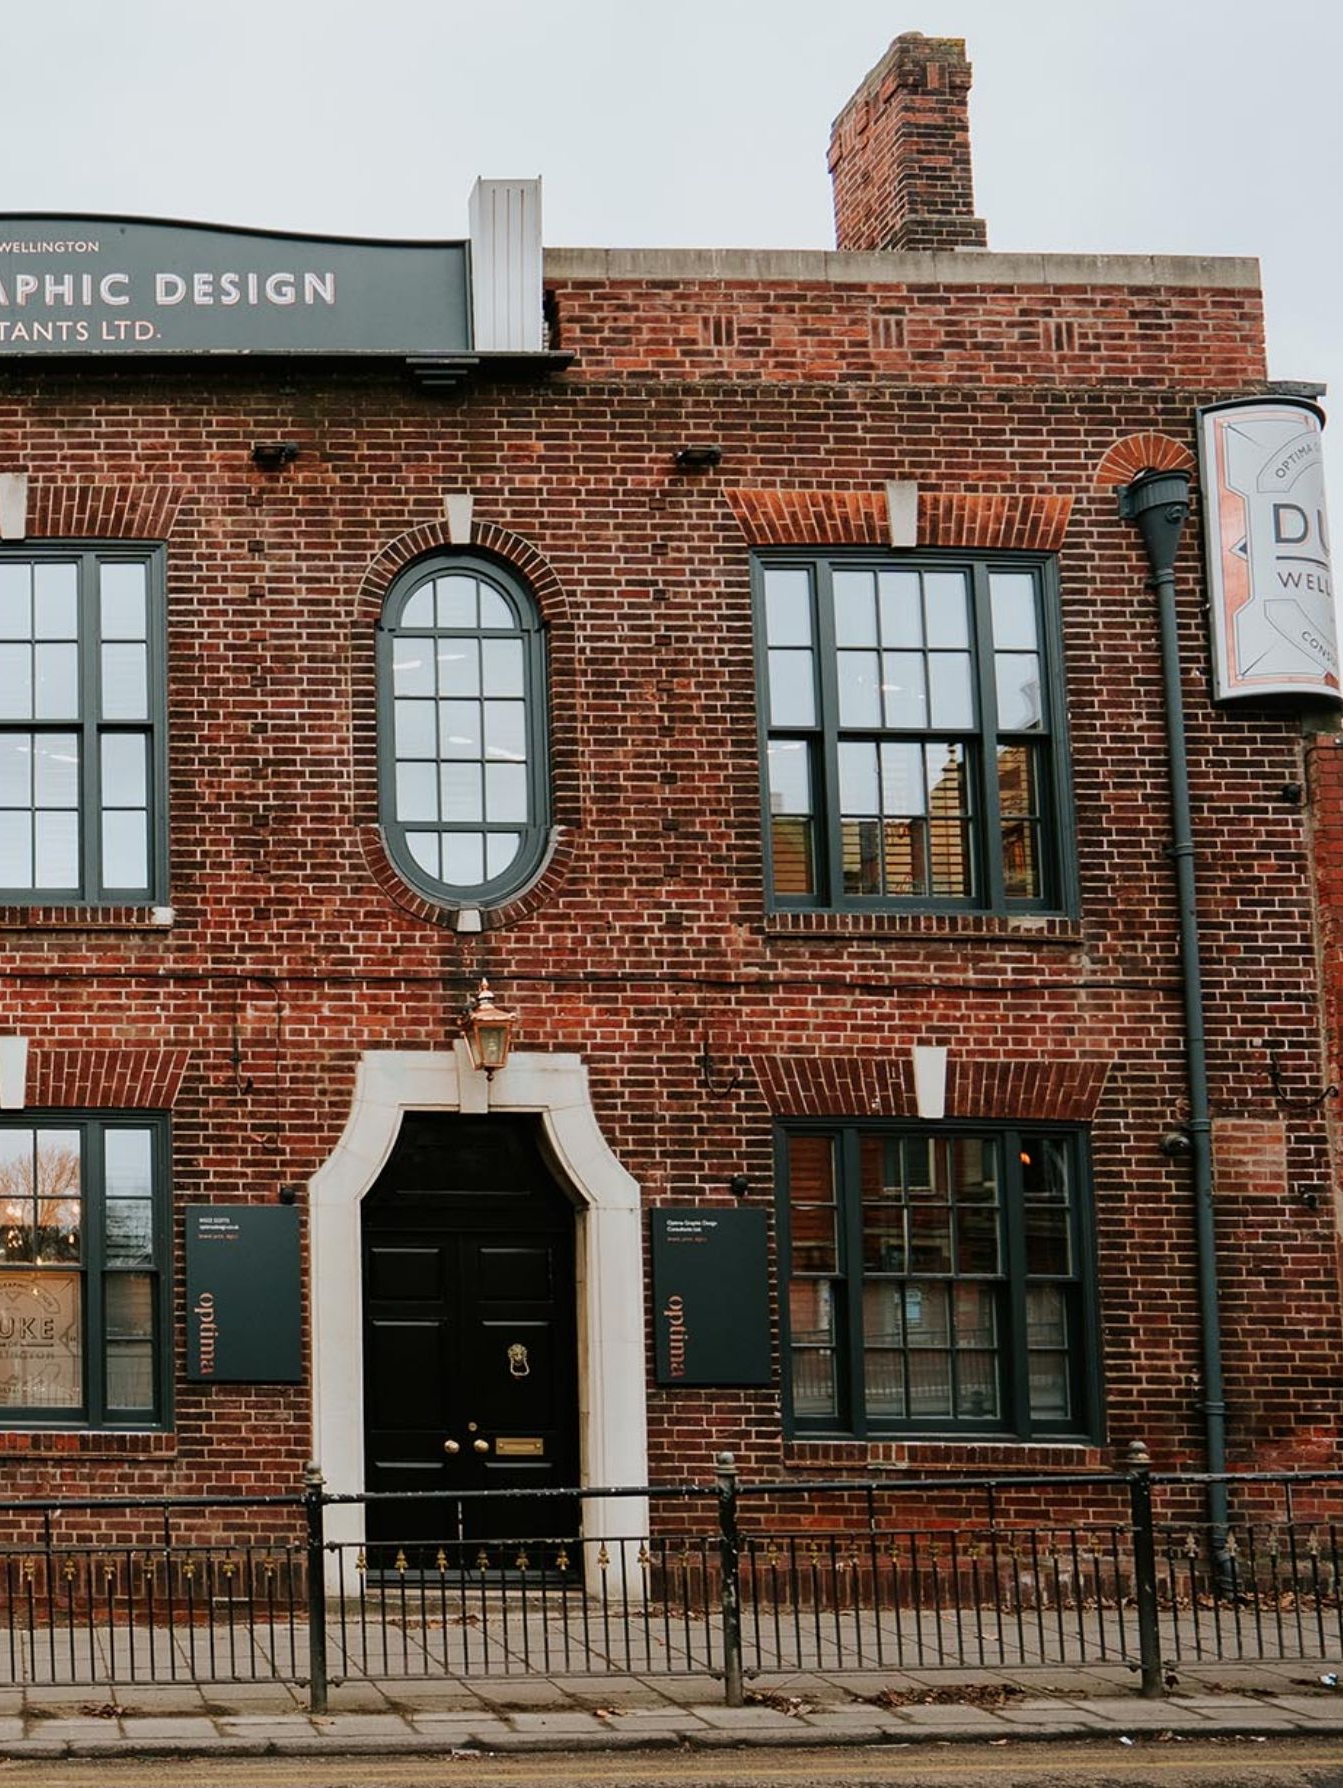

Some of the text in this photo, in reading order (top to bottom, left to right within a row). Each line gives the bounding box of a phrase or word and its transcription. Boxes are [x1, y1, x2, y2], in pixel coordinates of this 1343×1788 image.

[154, 272, 336, 306] DESIGN
[101, 320, 162, 341] LTD.
[194, 1292, 219, 1374] optima
[663, 1295, 690, 1378] optima
